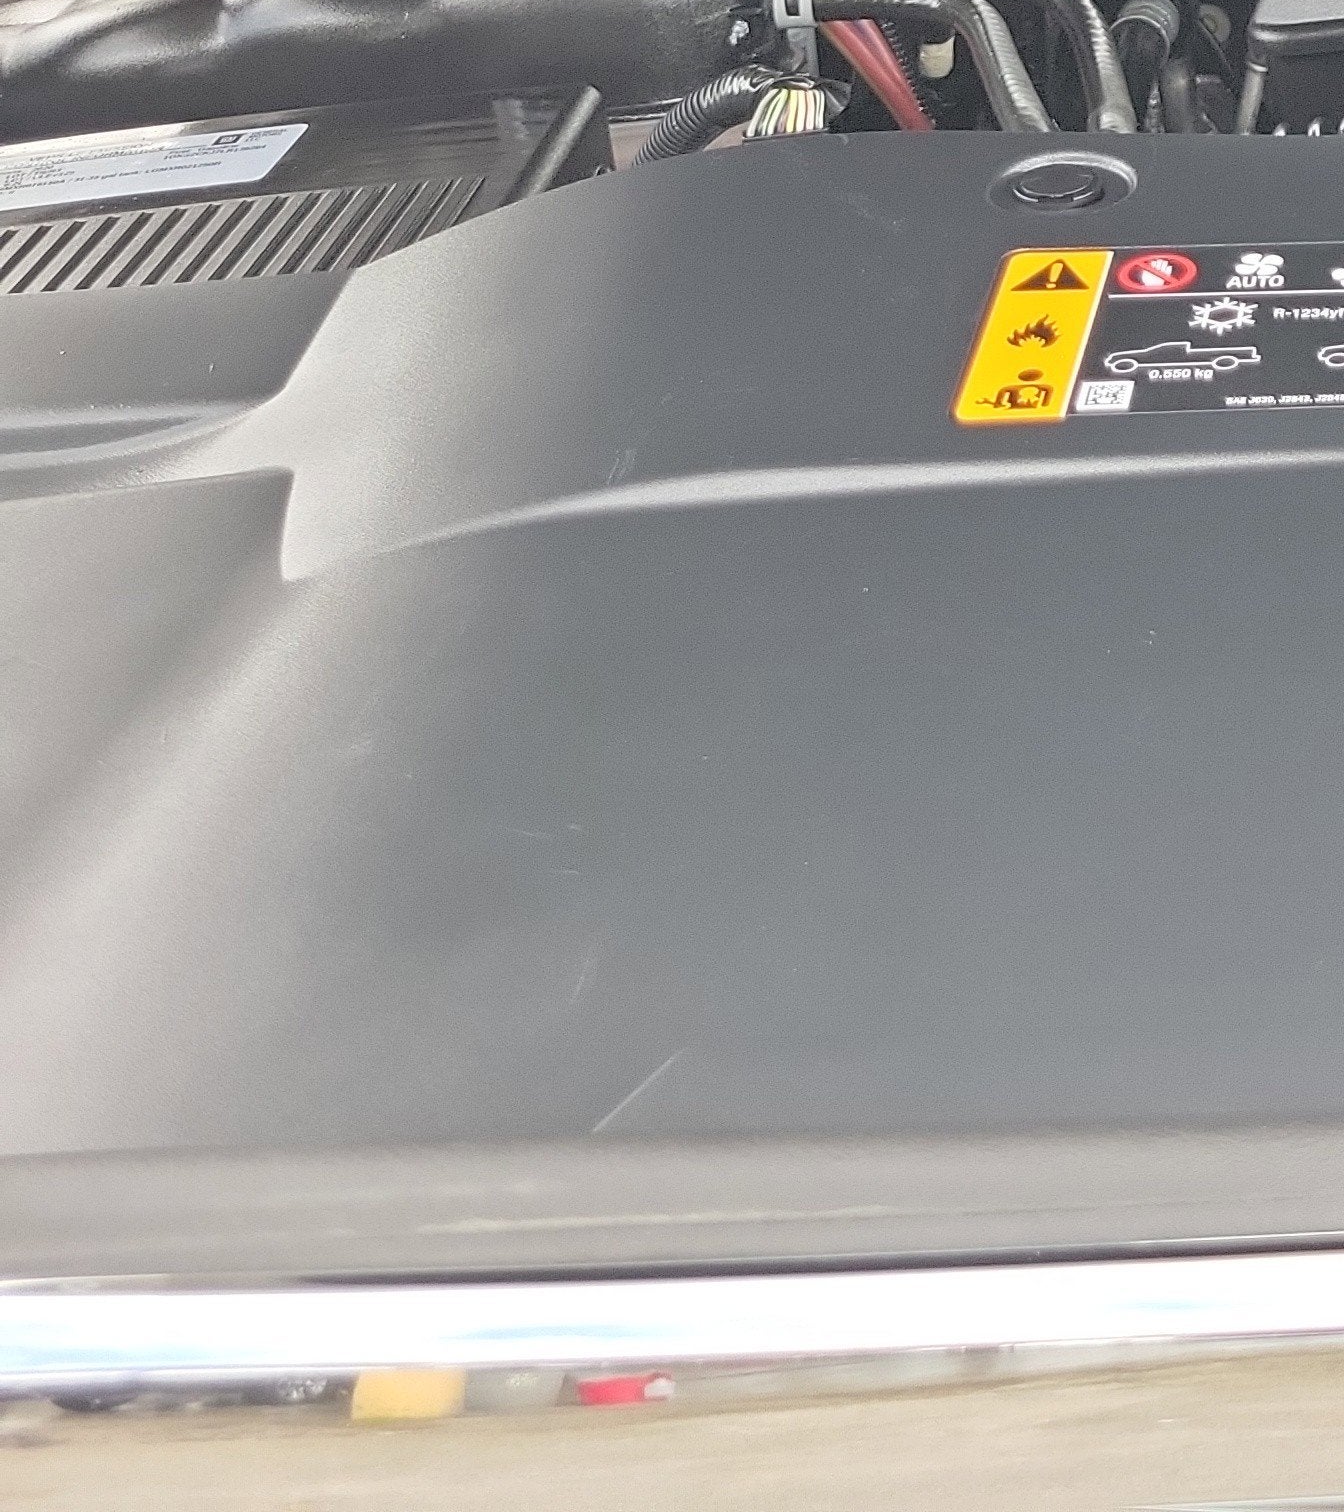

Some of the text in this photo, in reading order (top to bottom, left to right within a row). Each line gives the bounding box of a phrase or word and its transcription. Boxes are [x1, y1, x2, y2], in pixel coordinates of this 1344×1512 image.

[1225, 274, 1285, 288] AUTO
[1273, 306, 1344, 320] R-1234yf
[1194, 368, 1214, 381] kg
